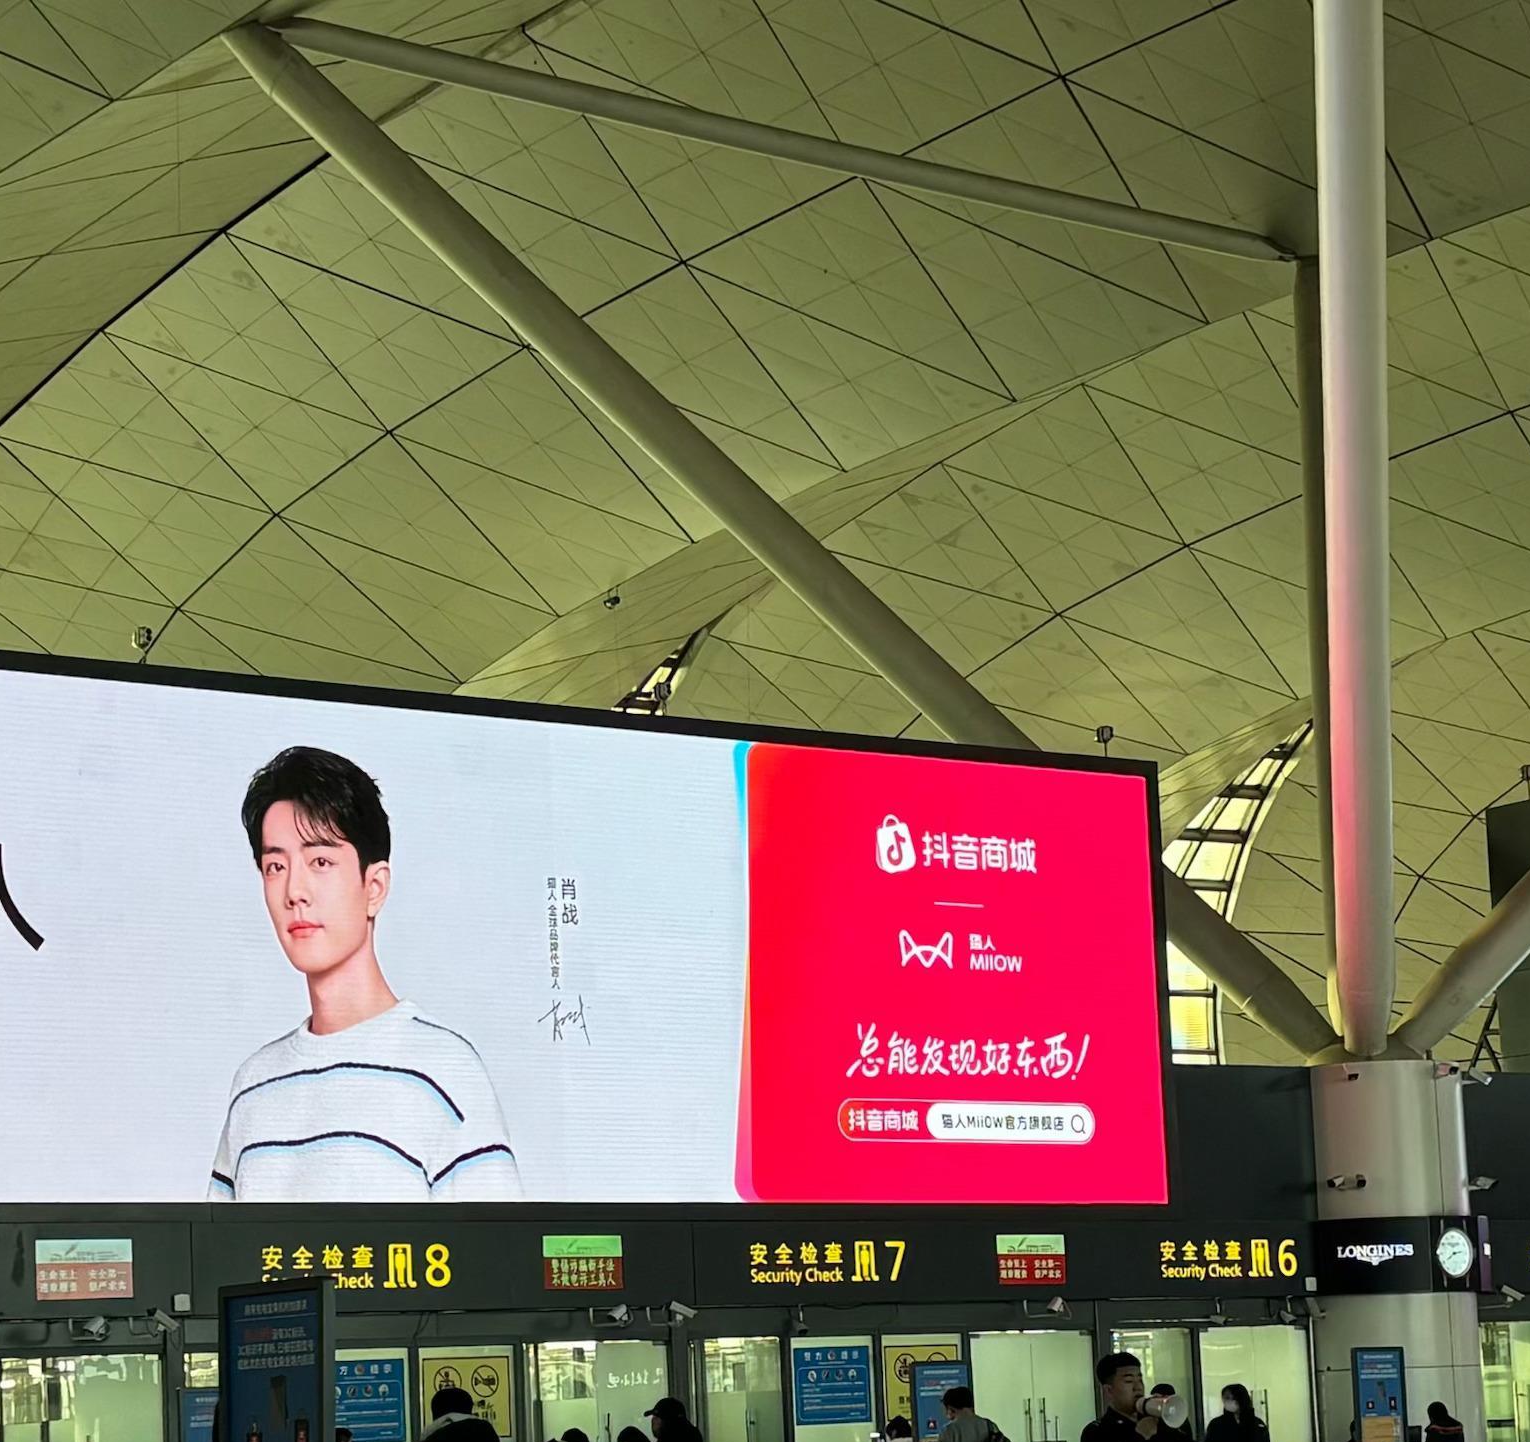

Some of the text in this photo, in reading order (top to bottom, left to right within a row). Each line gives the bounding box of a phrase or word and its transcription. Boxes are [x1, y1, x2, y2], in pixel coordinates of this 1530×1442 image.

[922, 831, 1038, 875] 抖音商城
[561, 878, 579, 925] 肖战
[968, 932, 997, 952] 猫人
[969, 953, 1023, 974] MIIOW
[847, 1107, 919, 1133] 抖音商城
[749, 1240, 907, 1282] 安全检查 7
[1160, 1238, 1299, 1278] 安全检查 6
[1336, 1243, 1415, 1260] LONGINES
[261, 1242, 452, 1289] 安全检查 8
[750, 1266, 845, 1287] Security Check
[1160, 1263, 1243, 1281] Security Check
